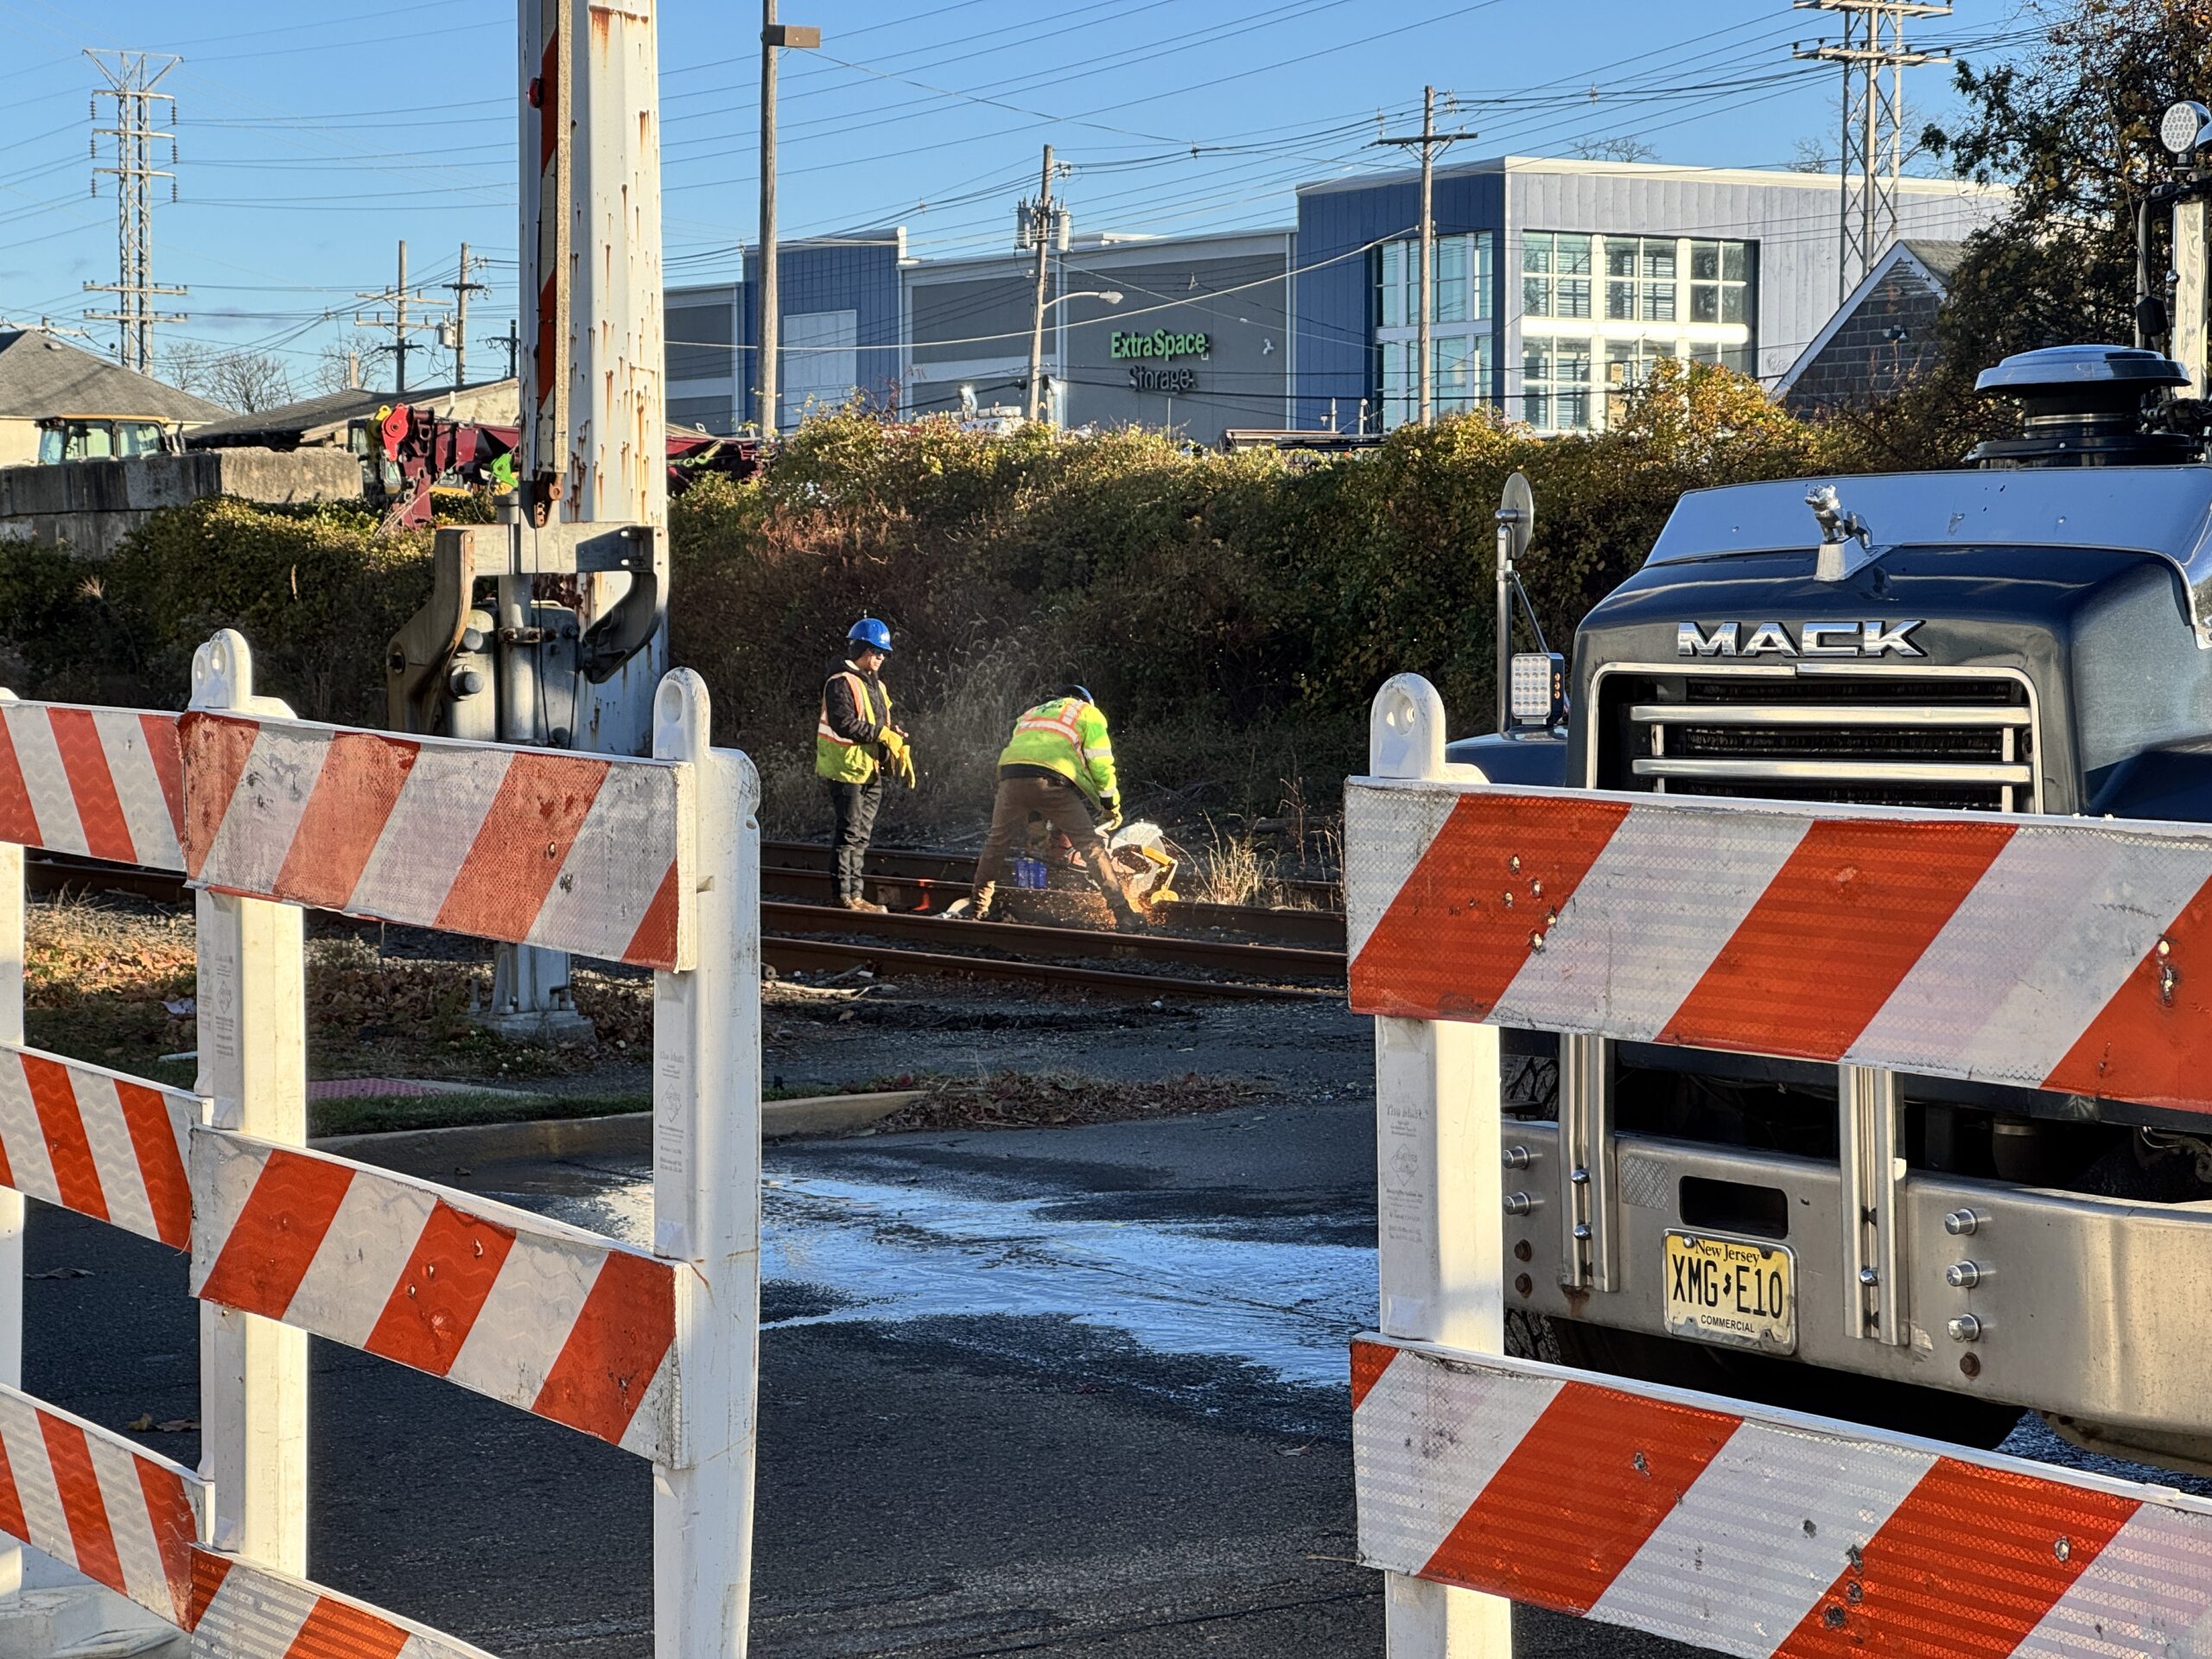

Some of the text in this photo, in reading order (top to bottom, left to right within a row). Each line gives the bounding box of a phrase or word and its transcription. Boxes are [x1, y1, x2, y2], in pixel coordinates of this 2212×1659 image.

[1111, 328, 1207, 361] ExtraSpace
[1128, 365, 1193, 395] Storage
[1677, 620, 1928, 657] MACK
[1695, 1239, 1760, 1267] New Jersey
[1672, 1254, 1783, 1319] XMG E10
[1700, 1314, 1755, 1333] COMMERCIAL
